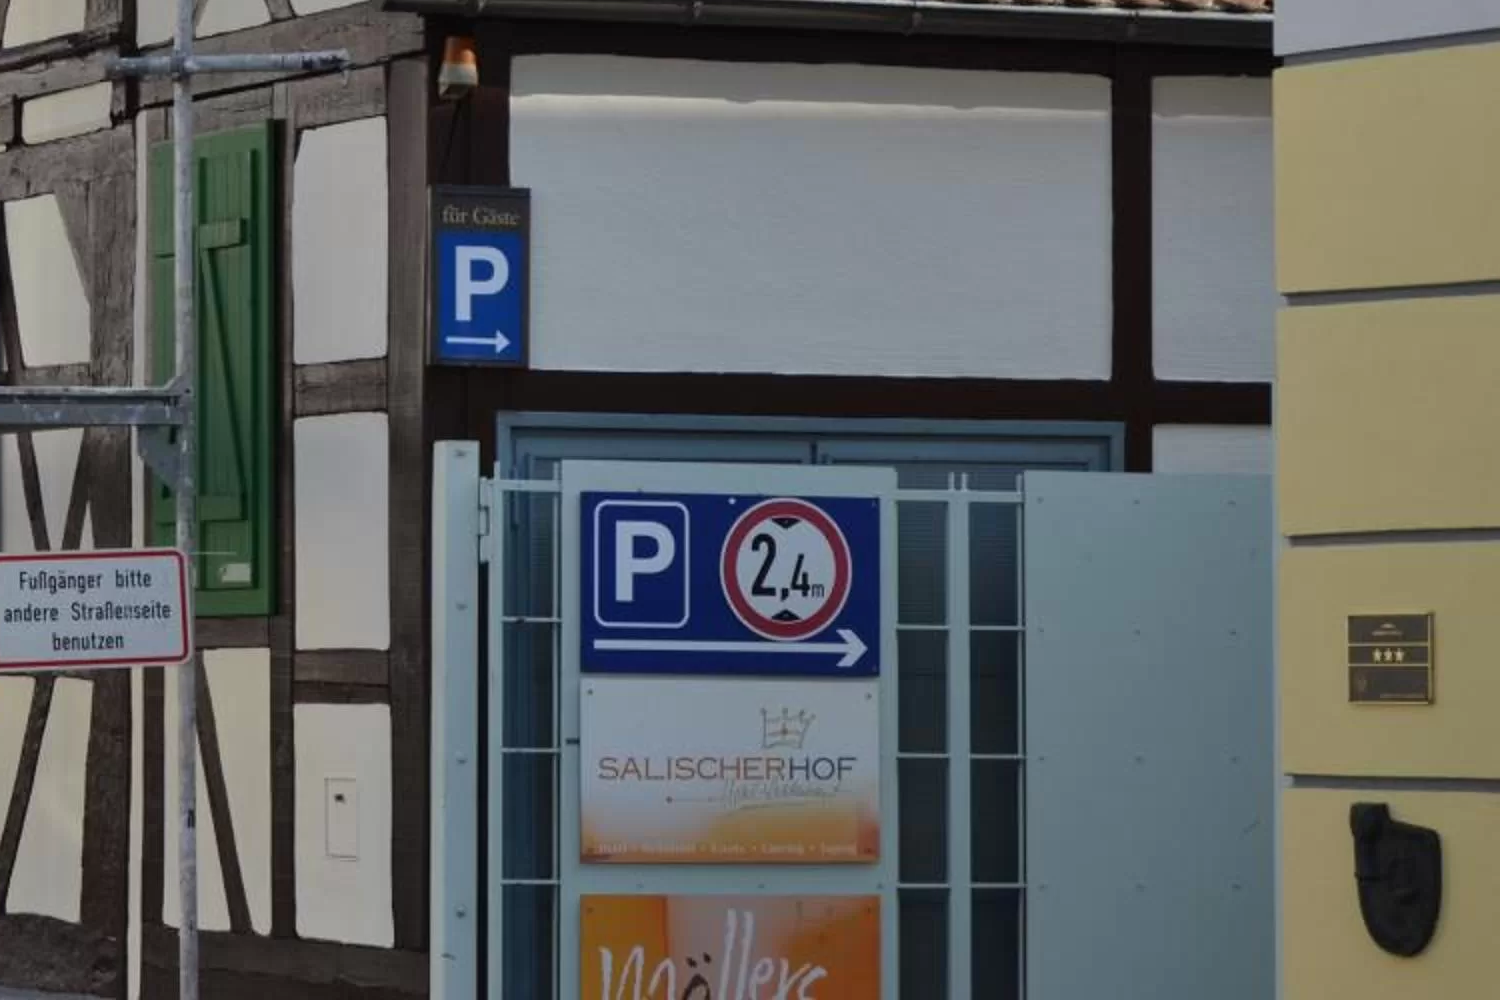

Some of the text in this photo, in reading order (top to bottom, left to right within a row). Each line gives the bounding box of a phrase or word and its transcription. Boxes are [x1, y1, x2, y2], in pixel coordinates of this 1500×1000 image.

[442, 204, 521, 226] für Gäste
[455, 245, 509, 322] P
[615, 520, 676, 603] P
[19, 569, 152, 595] Fußgänger bitte
[4, 600, 172, 623] andere Straßenseite
[51, 632, 125, 651] benutzen
[598, 756, 857, 782] SALISCHERHOF
